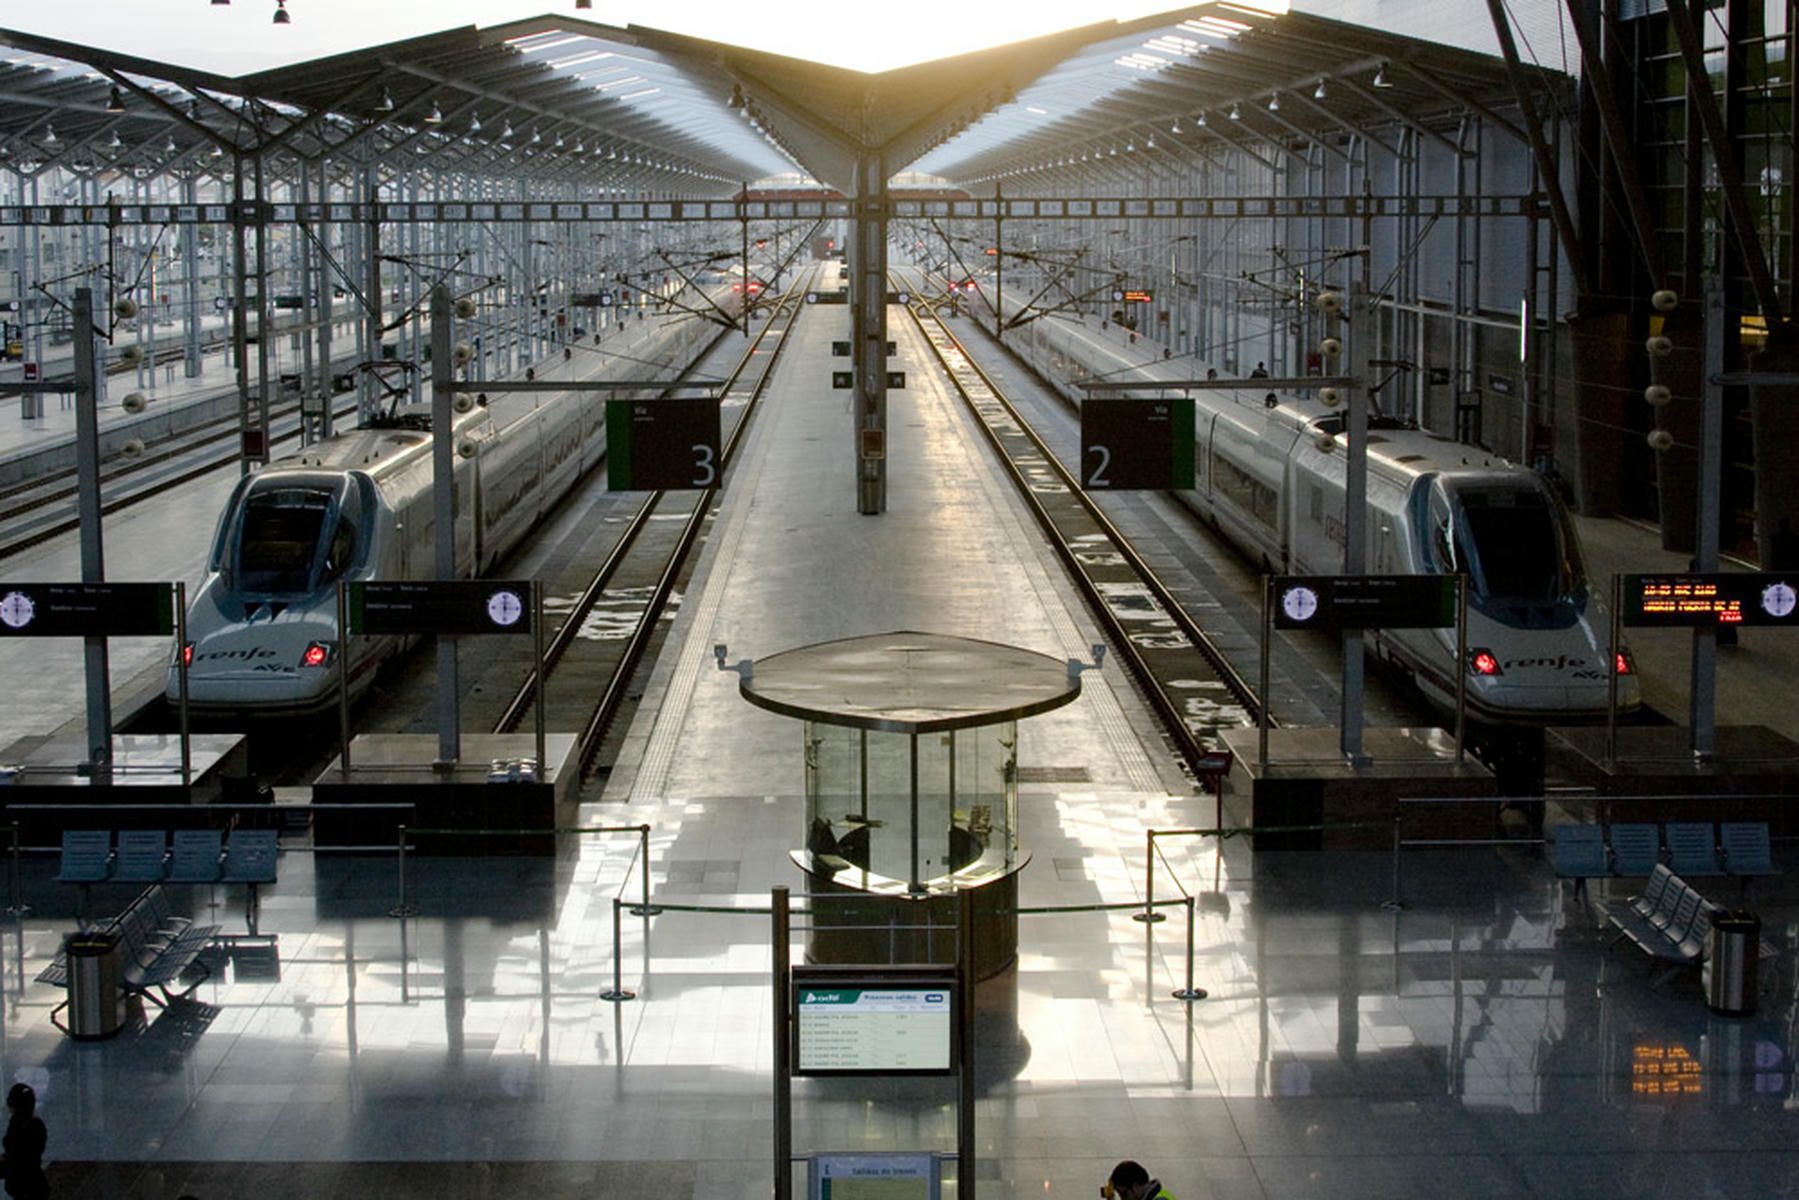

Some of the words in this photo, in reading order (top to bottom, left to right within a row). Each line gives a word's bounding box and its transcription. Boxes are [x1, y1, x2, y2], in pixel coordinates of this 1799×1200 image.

[692, 444, 715, 487] 3
[1087, 445, 1110, 487] 2
[197, 645, 277, 662] renfe
[1503, 654, 1586, 670] renfe
